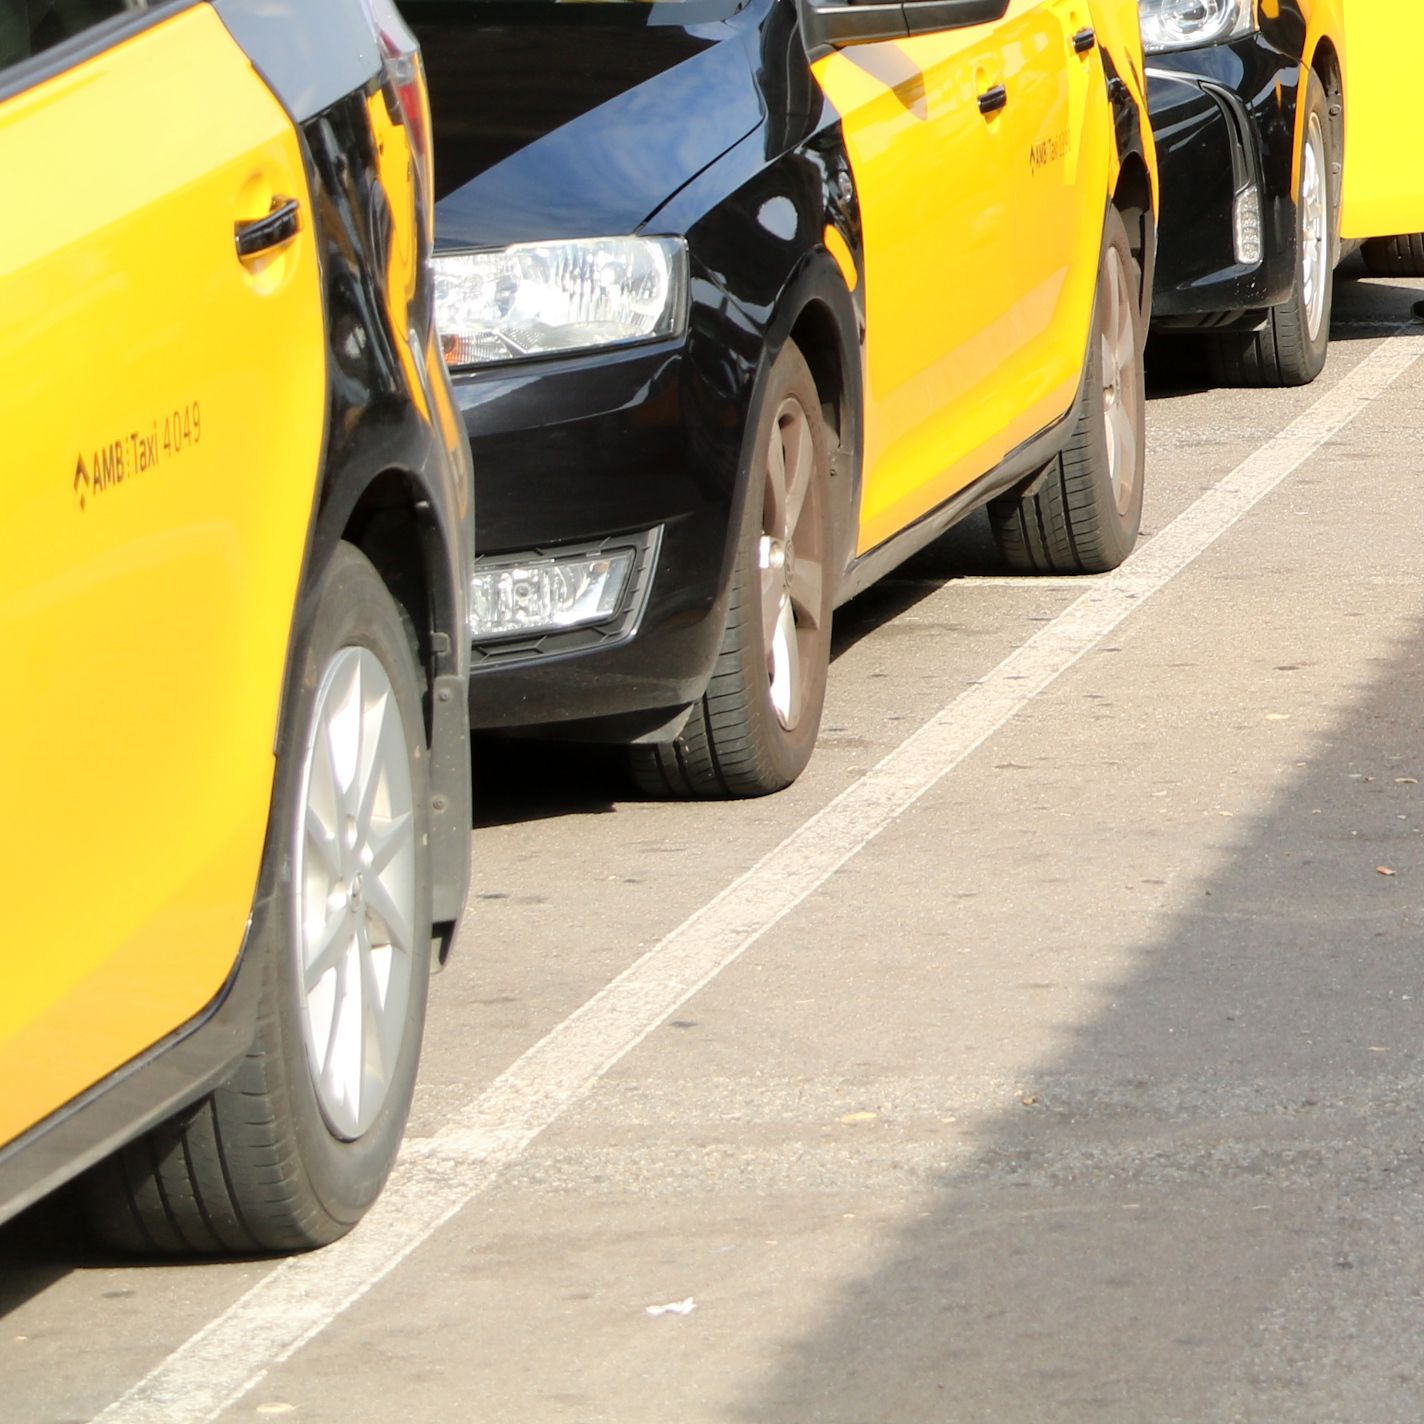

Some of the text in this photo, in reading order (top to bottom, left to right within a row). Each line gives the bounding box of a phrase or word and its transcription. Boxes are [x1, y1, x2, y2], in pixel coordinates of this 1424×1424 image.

[93, 399, 200, 497] AMB Taxi 4049
